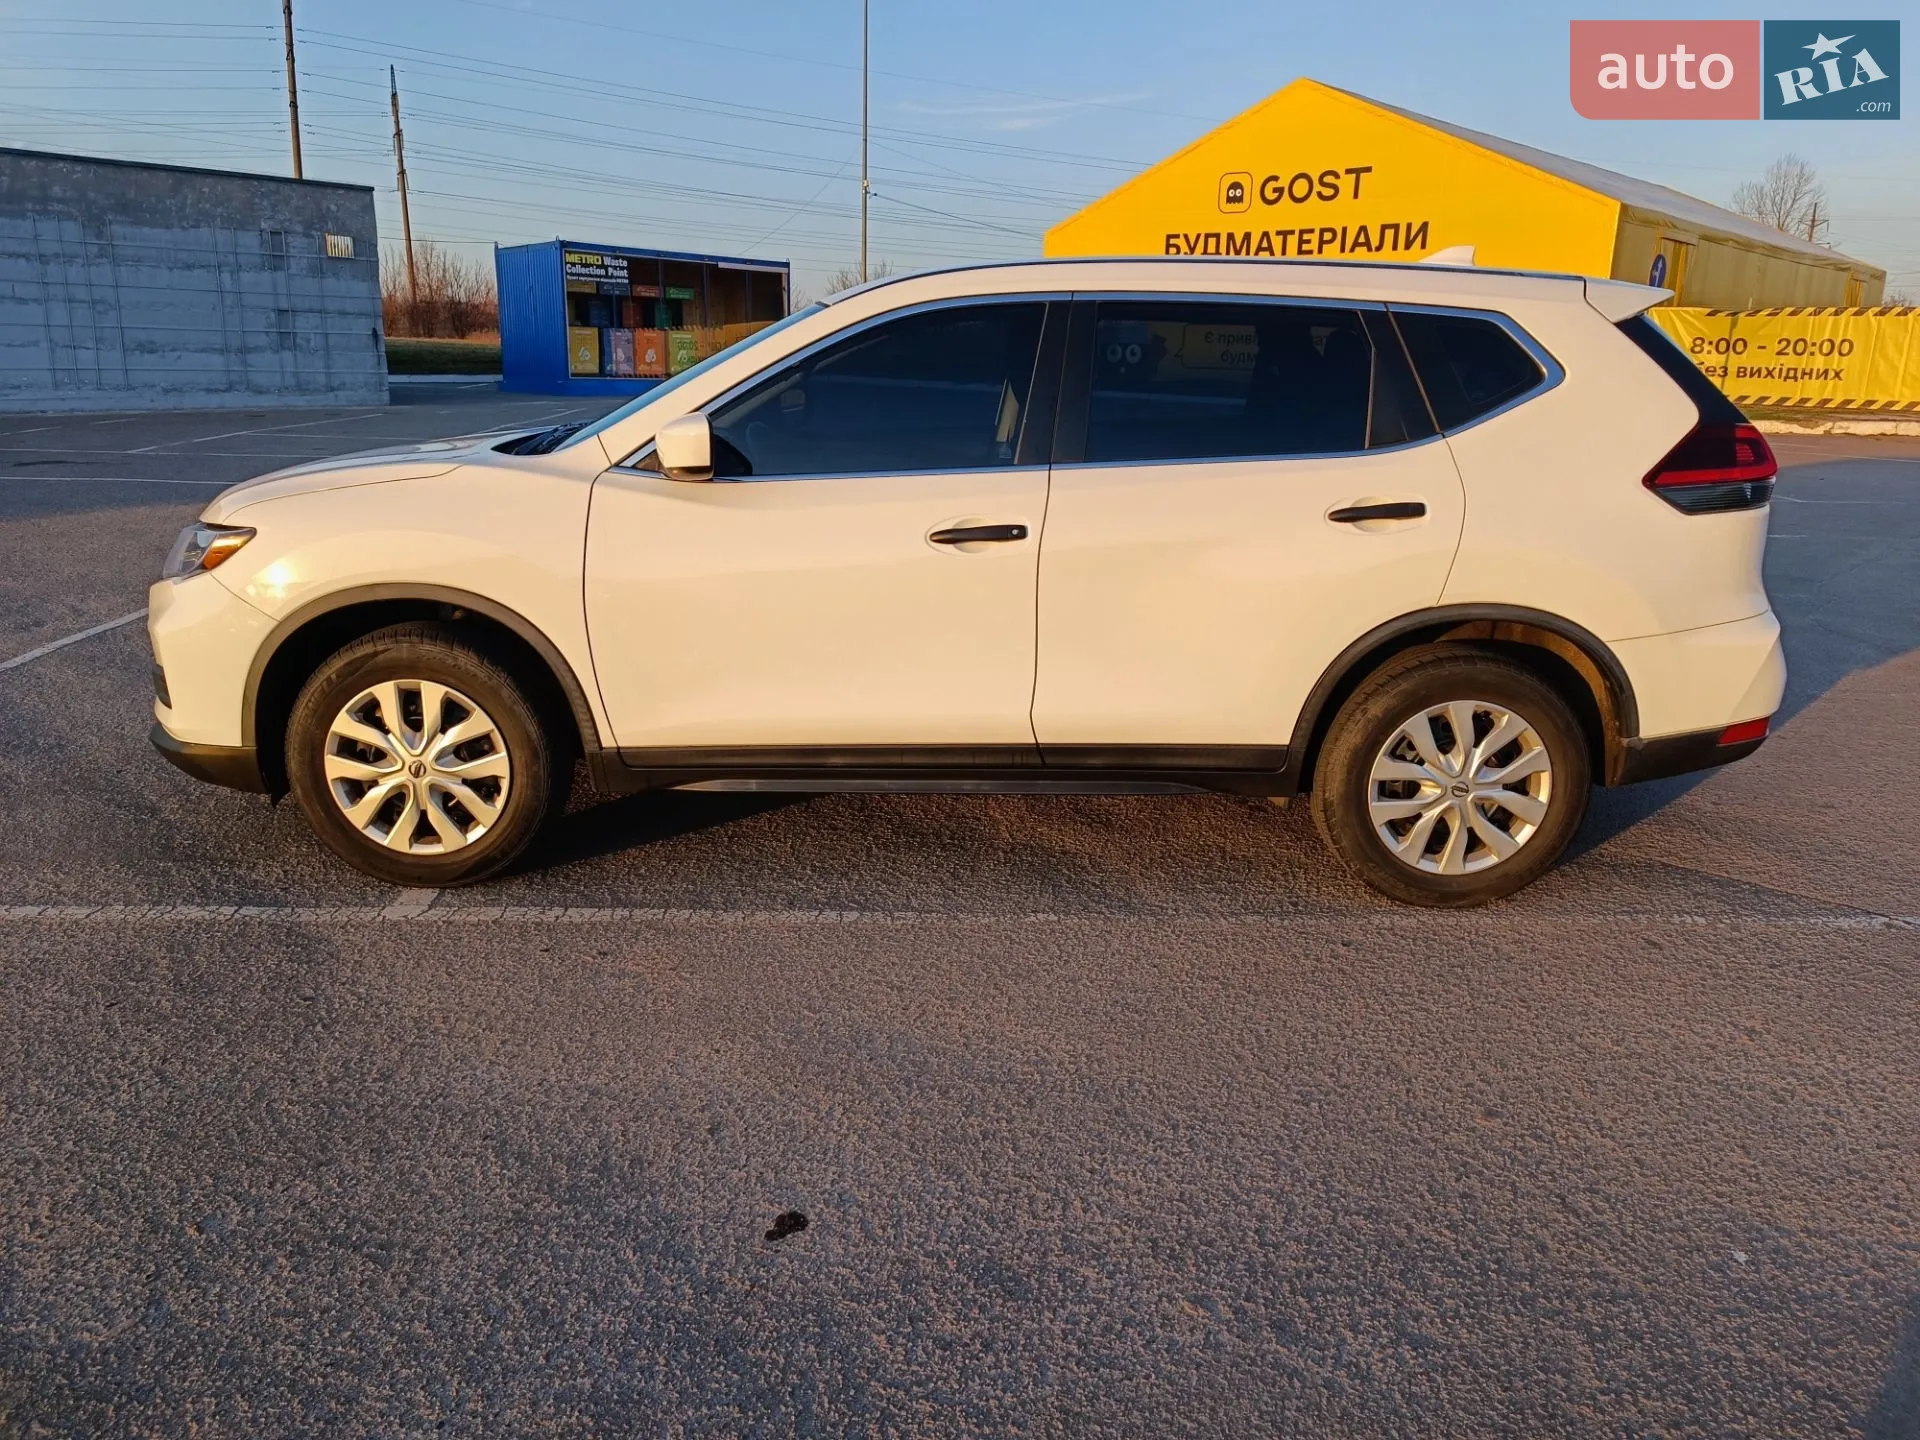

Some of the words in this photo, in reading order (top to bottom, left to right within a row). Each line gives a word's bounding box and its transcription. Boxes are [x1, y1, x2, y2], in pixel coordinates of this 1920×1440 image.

[1259, 166, 1373, 206] GOST
[1164, 221, 1430, 257] БУДМАТЕРІАЛИ
[565, 253, 602, 265] METRO
[603, 256, 628, 267] Waste
[566, 264, 606, 275] Collection
[607, 267, 629, 277] Point
[1690, 336, 1748, 356] 8:00
[1775, 337, 1855, 357] 20:00
[1736, 363, 1844, 383] вихідних
